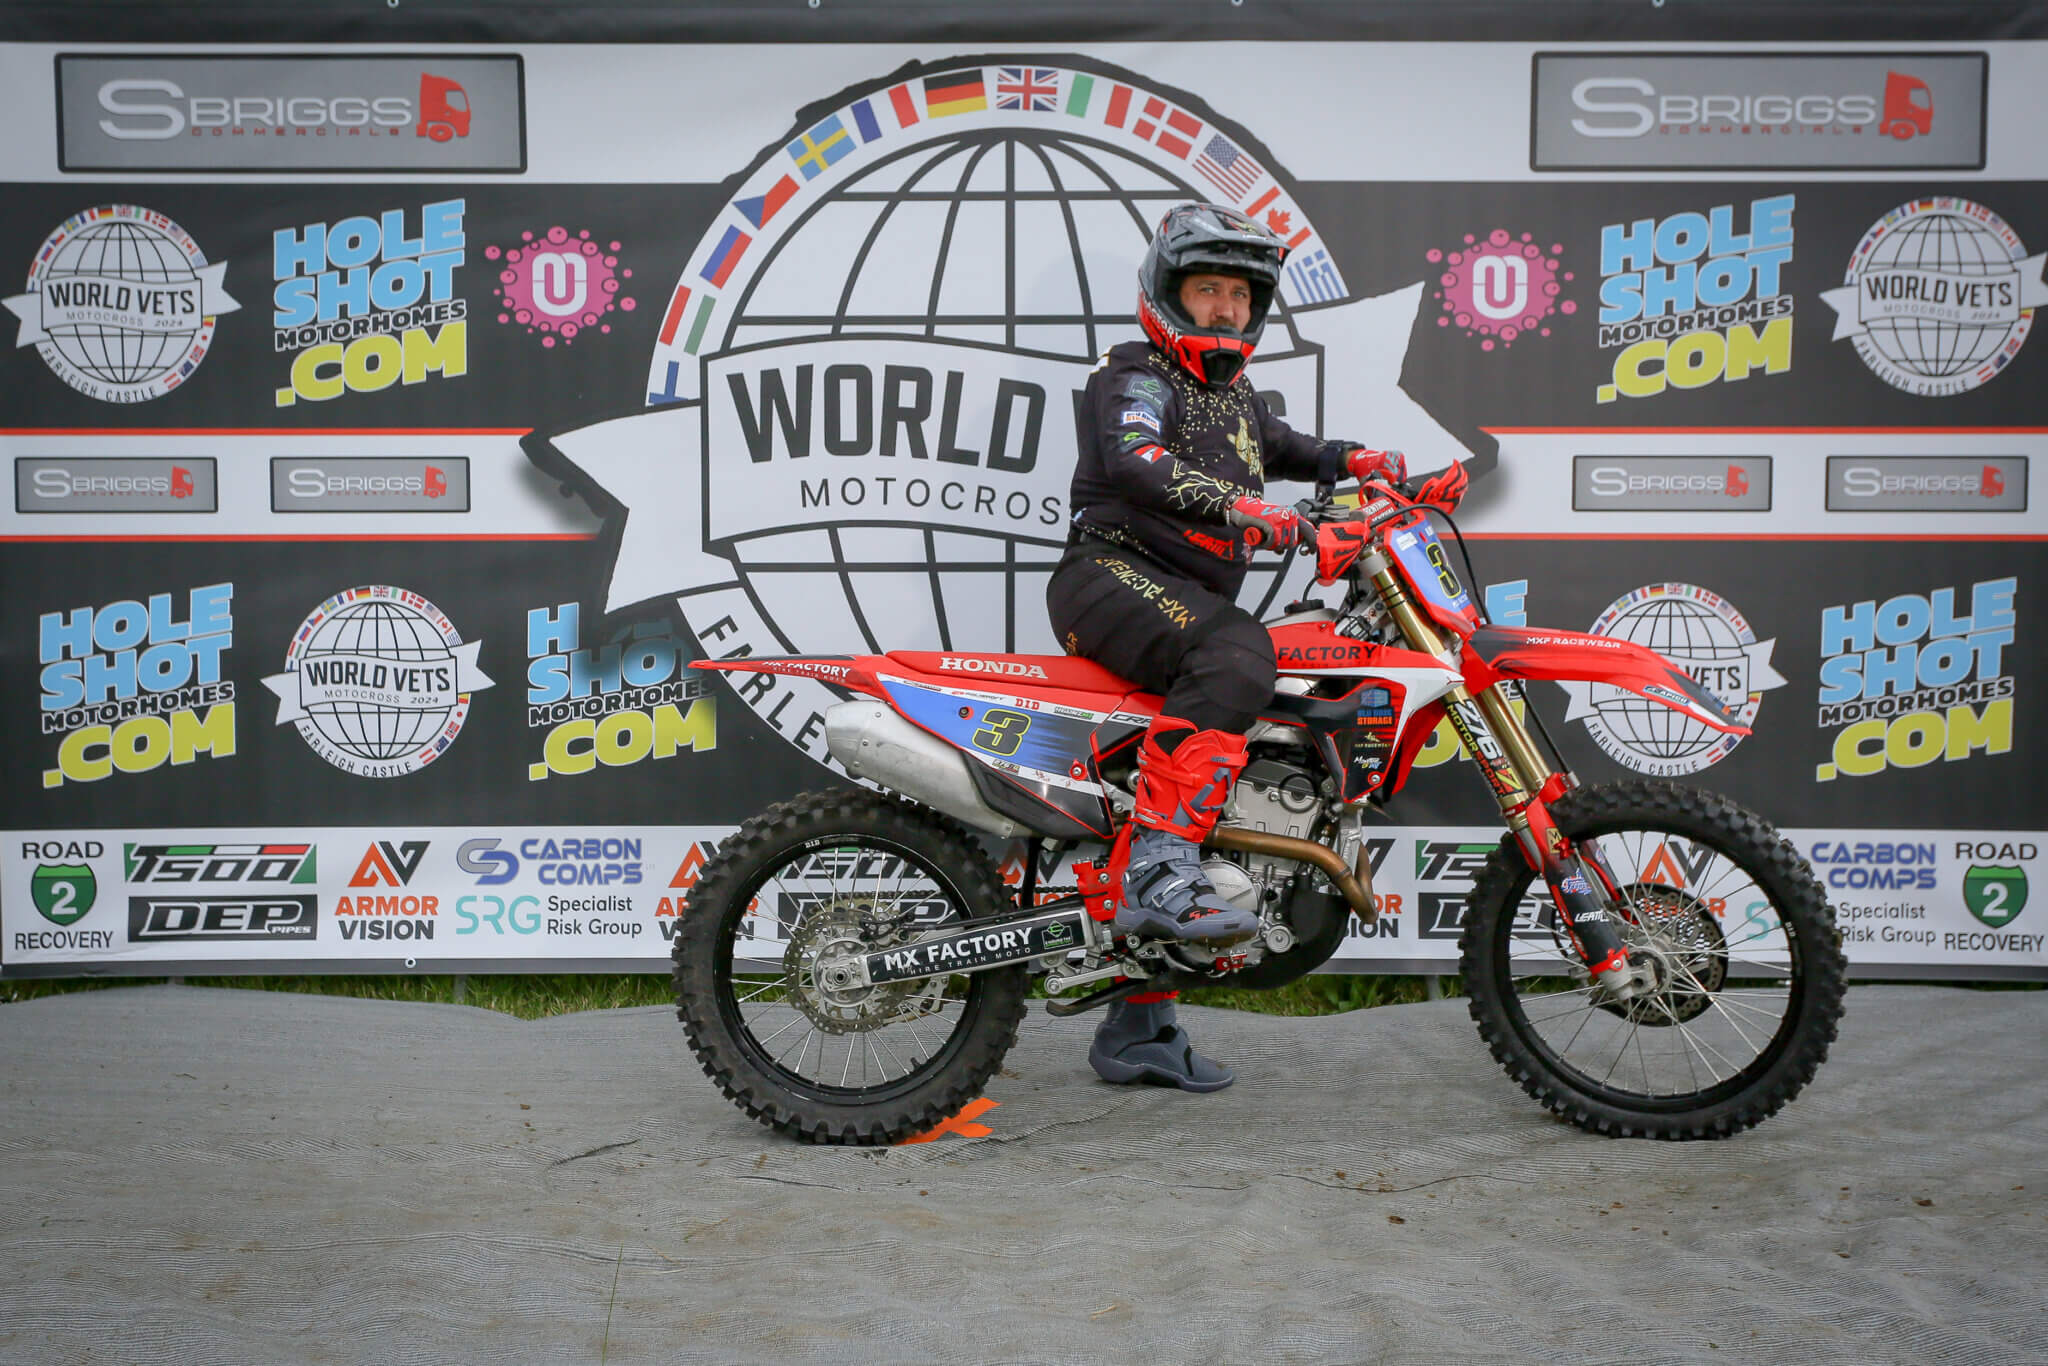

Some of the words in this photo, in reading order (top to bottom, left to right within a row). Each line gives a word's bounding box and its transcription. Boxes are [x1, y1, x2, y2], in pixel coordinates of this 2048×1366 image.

[191, 127, 400, 137] COMMERCIALS
[273, 198, 466, 281] HOLE
[1600, 193, 1796, 278] HOLE
[49, 282, 131, 311] WORLD
[138, 289, 195, 315] VETS
[273, 249, 465, 329] SHOT
[1599, 245, 1793, 325] SHOT
[1866, 275, 1948, 304] WORLD
[1956, 282, 2012, 308] VETS
[66, 311, 144, 327] MOTOCROSS
[154, 319, 184, 328] 2024
[275, 298, 467, 352] MOTORHOMES
[1599, 294, 1793, 348] MOTORHOMES
[1883, 304, 1961, 319] MOTOCROSS
[41, 349, 98, 397] FARLEIGH
[105, 386, 157, 402] CASTLE
[276, 319, 467, 408] .COM
[1596, 316, 1793, 404] .COM
[1857, 341, 1910, 389] FARLEIGH
[1917, 379, 1968, 396] CASTLE
[726, 364, 1047, 474] WORLD
[800, 477, 1062, 526] MOTOCROS
[1425, 542, 1462, 599] 3
[40, 582, 233, 665] HOLE
[1820, 576, 2018, 658] HOLE
[1277, 645, 1379, 662] FACTORY
[1526, 636, 1551, 646] MXF
[40, 631, 232, 711] SHOT
[305, 660, 387, 689] WORLD
[394, 667, 450, 693] VETS
[939, 656, 1049, 680] HONDA
[1819, 626, 2015, 705] SHOT
[42, 680, 235, 734] MOTORHOMES
[324, 689, 401, 704] MOTOCROSS
[1819, 676, 2015, 727] MOTORHOMES
[43, 701, 236, 789] .COM
[300, 724, 355, 773] FARLEIGH
[361, 761, 412, 777] CASTLE
[529, 697, 717, 781] .COM
[972, 708, 1032, 757] 3
[1588, 723, 1642, 772] FARLEIGH
[1648, 760, 1699, 777] CASTLE
[1816, 697, 2014, 783] .COM
[21, 841, 105, 860] ROAD
[519, 838, 642, 861] CARBON
[1811, 841, 1937, 865] CARBON
[1955, 841, 2039, 861] ROAD
[538, 862, 643, 886] COMPS
[1828, 867, 1938, 890] COMPS
[51, 881, 78, 916] 2
[335, 895, 439, 917] ARMOR
[455, 895, 542, 936] SRG
[547, 894, 633, 913] Specialist
[1838, 902, 1927, 921] Specialist
[1981, 882, 2009, 918] 2
[139, 900, 303, 937] DEP
[271, 925, 312, 935] PIPES
[338, 919, 434, 941] VISION
[547, 918, 582, 936] Risk
[588, 918, 643, 939] Group
[1839, 926, 1875, 943] Risk
[1880, 926, 1937, 947] Group
[15, 930, 114, 951] RECOVERY
[884, 950, 921, 972] MX
[927, 926, 1033, 964] FACTORY
[948, 955, 987, 969] TRAIN
[996, 947, 1032, 960] MOTO
[1944, 932, 2046, 953] RECOVERY
